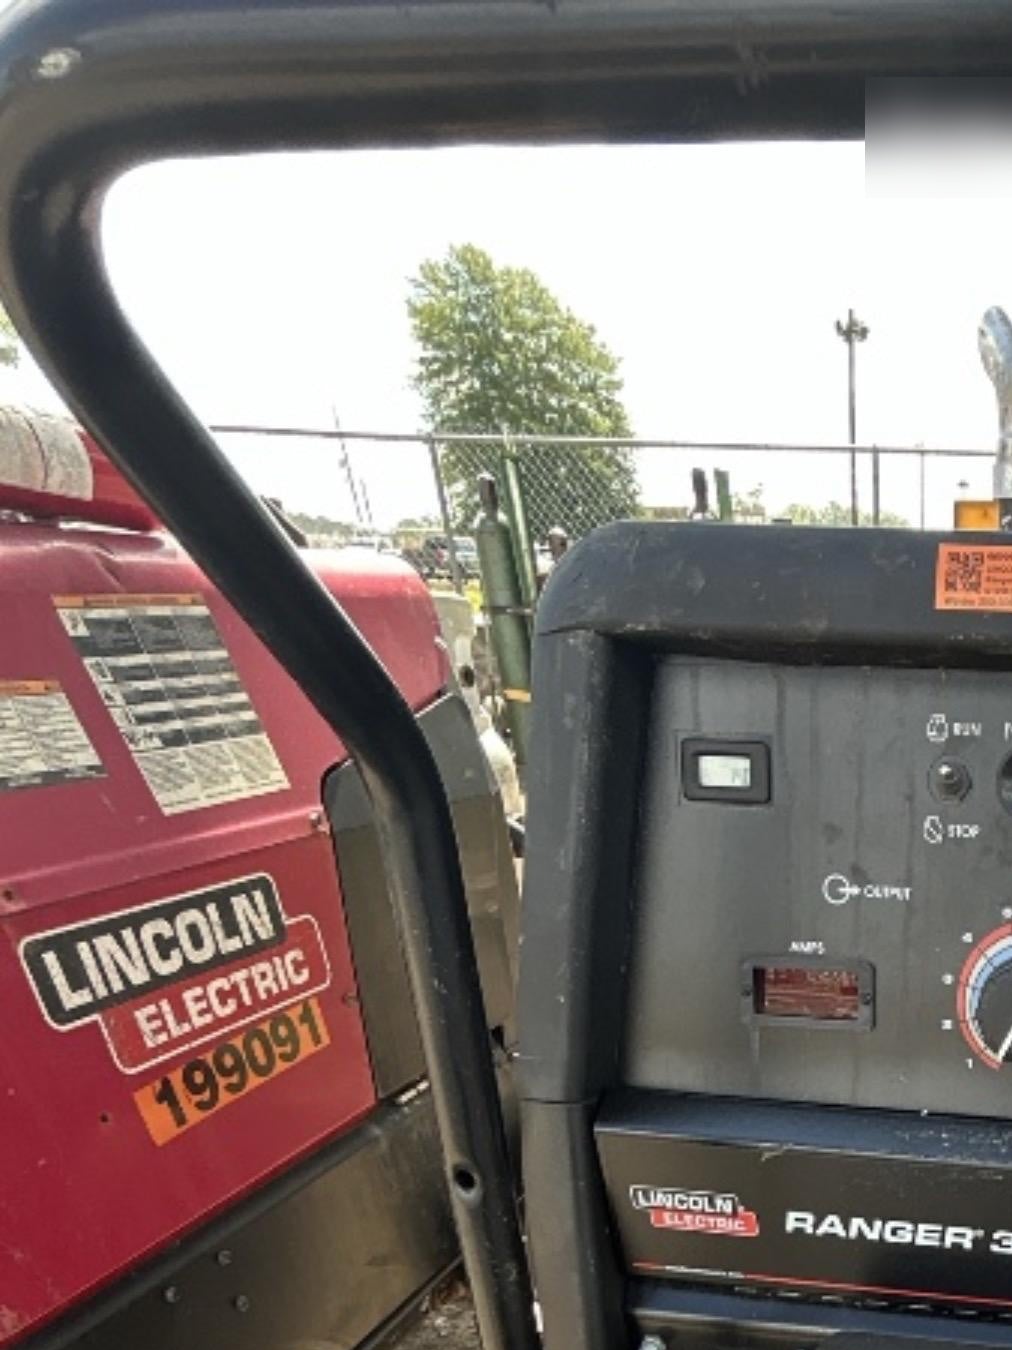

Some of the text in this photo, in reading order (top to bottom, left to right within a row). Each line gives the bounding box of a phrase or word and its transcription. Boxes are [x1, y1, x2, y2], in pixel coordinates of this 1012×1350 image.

[953, 722, 982, 736] RUN
[947, 823, 981, 839] STOP
[41, 888, 276, 1012] LINCOLN
[133, 948, 311, 1049] ELECTRIC
[153, 1000, 322, 1129] 199091
[965, 1058, 974, 1070] 1
[637, 1189, 733, 1215] LINCOLN
[663, 1210, 748, 1232] ELECTRIC
